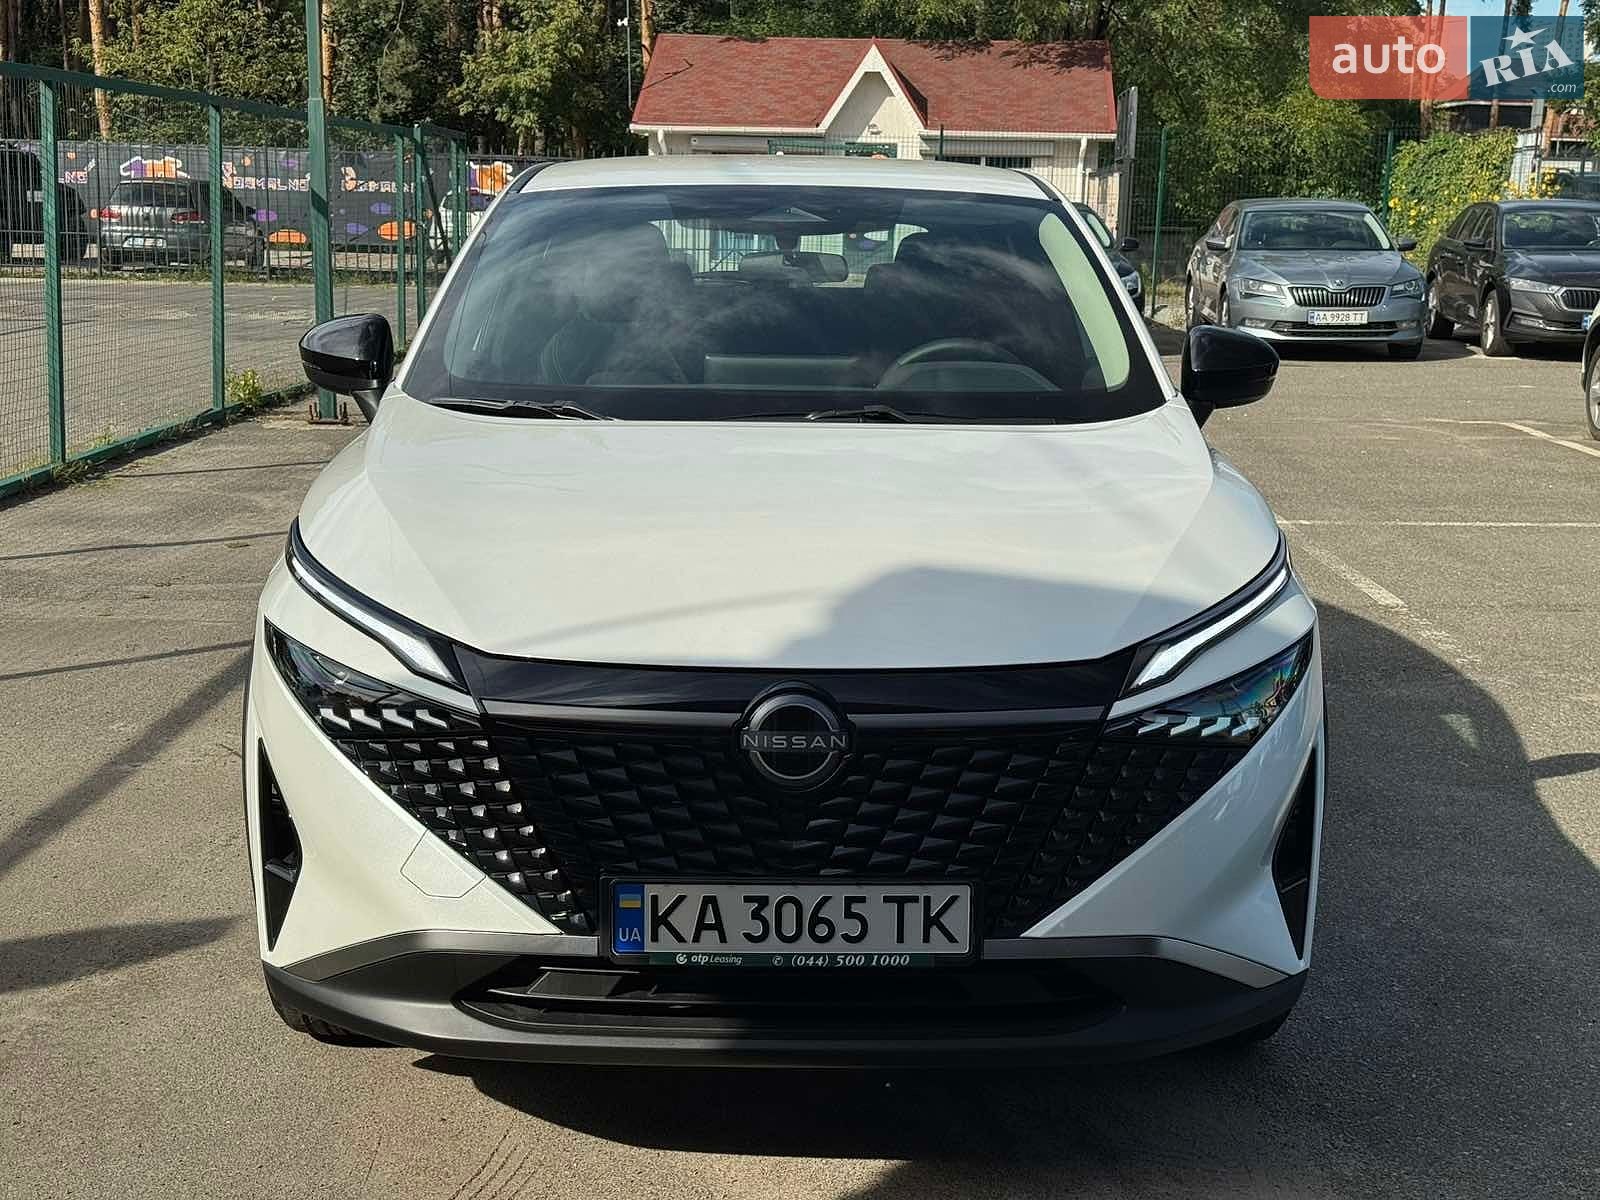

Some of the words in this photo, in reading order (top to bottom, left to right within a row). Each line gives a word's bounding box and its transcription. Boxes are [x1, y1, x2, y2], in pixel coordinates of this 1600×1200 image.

[743, 734, 846, 749] NISSAN
[619, 927, 642, 943] UA
[650, 894, 728, 944] KA
[741, 894, 869, 944] 3065
[882, 894, 960, 944] TK
[791, 954, 829, 967] (044)
[834, 954, 865, 967] 500
[871, 954, 910, 967] 1000
